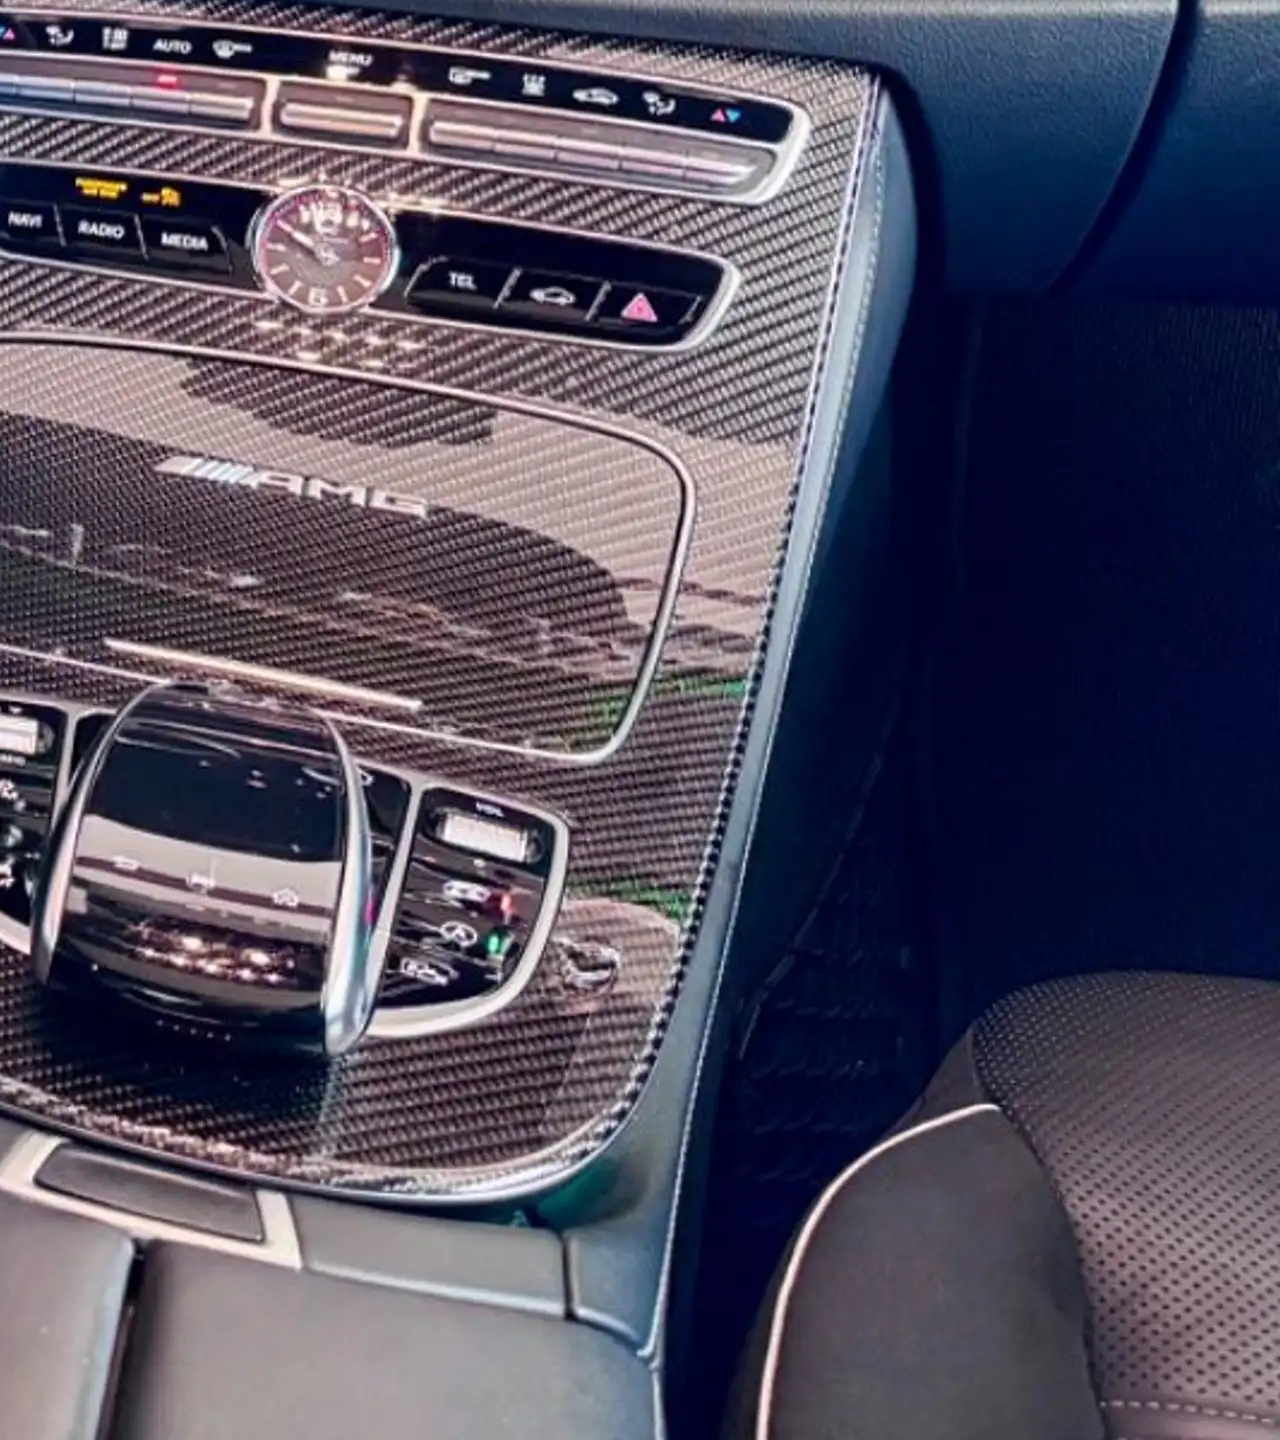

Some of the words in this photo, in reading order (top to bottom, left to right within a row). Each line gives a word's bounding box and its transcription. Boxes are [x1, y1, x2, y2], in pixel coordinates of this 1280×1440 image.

[153, 38, 192, 55] AUTO
[328, 49, 374, 67] MENU
[7, 211, 43, 229] NAVI
[77, 220, 126, 240] RADIO
[160, 232, 209, 252] MEDIA
[448, 270, 478, 291] TEL
[254, 468, 429, 518] AMG
